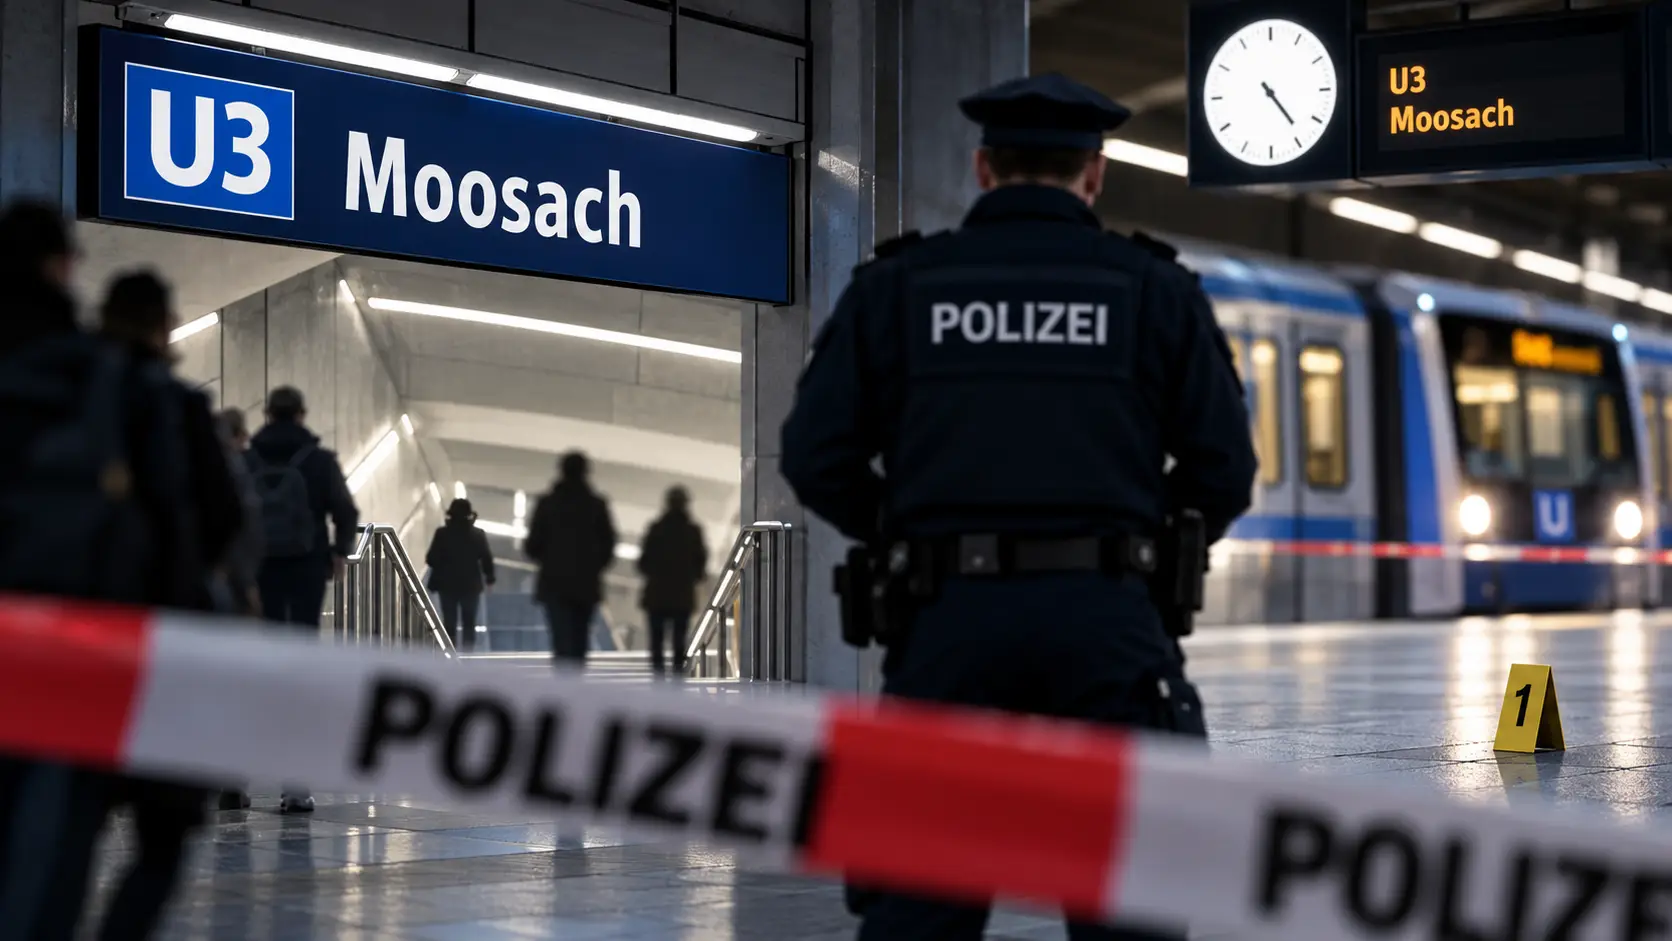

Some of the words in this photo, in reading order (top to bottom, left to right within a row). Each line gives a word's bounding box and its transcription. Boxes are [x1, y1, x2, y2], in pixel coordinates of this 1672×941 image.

[1389, 66, 1427, 95] U3
[1389, 98, 1515, 134] Moosach
[149, 89, 272, 196] U3
[345, 131, 641, 248] Moosach
[932, 301, 1107, 344] POLIZEI
[1538, 492, 1571, 536] U
[1515, 684, 1531, 727] 1
[353, 674, 828, 848] POLIZEI
